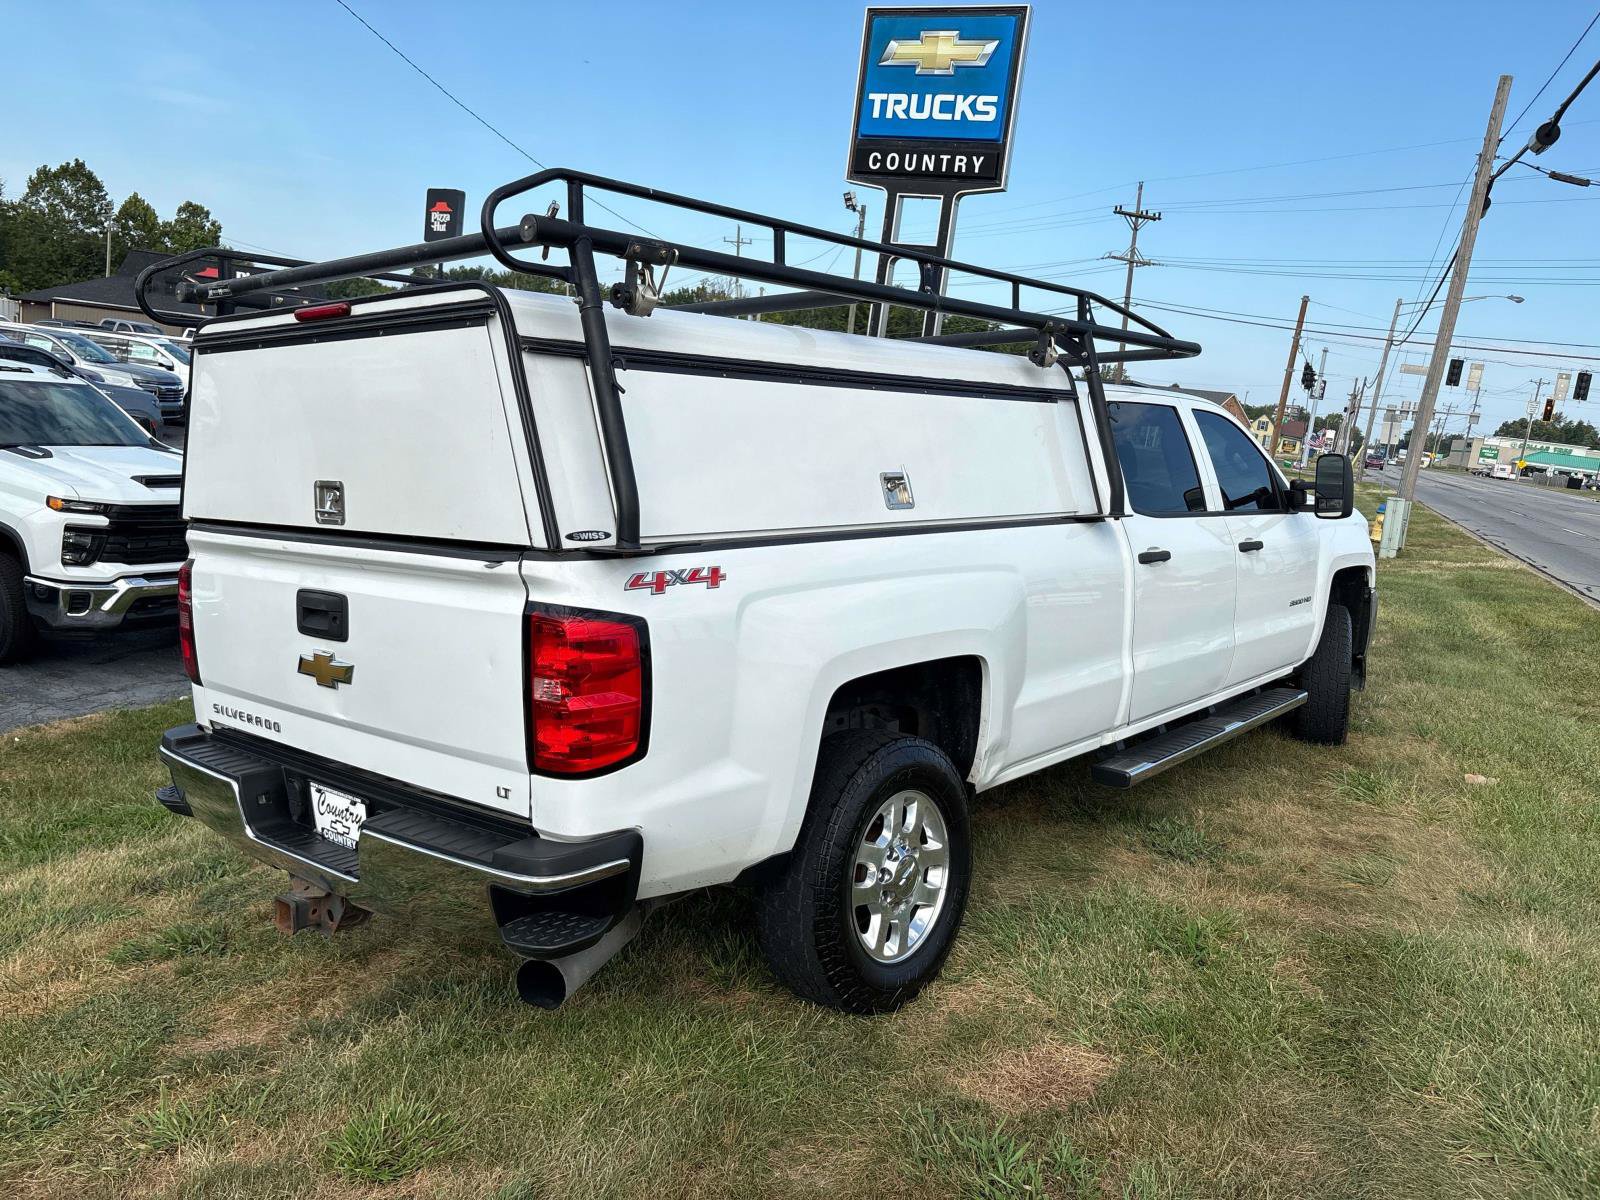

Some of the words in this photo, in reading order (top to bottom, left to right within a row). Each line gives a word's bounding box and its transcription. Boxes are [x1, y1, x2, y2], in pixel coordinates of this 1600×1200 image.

[868, 93, 998, 122] TRUCKS
[868, 152, 984, 174] COUNTRY
[430, 221, 447, 232] Hut
[431, 211, 451, 223] Pizza
[572, 531, 605, 540] SWISS
[212, 703, 282, 733] SILVERADO
[496, 785, 512, 800] LT
[317, 791, 363, 833] Country
[323, 829, 357, 850] COUNTRY
